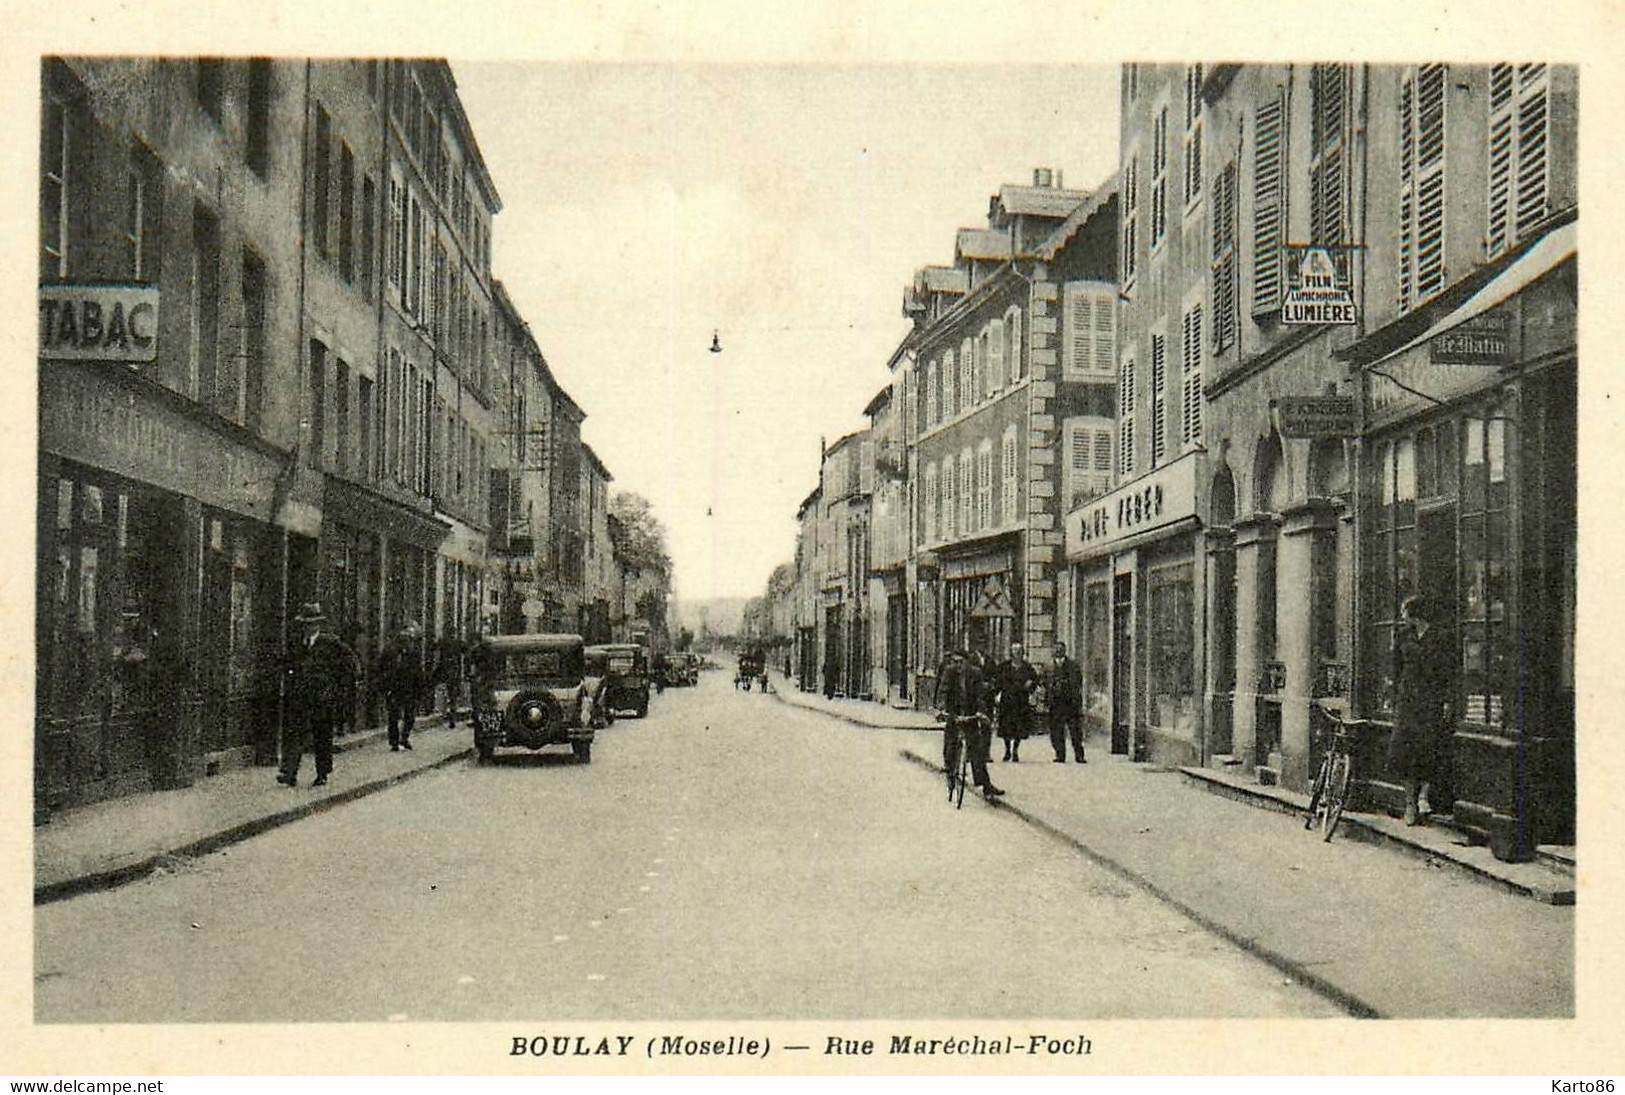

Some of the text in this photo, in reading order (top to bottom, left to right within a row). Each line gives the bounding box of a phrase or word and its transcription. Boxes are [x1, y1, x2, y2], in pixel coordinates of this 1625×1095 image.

[1284, 303, 1353, 321] LUMIÈRE
[40, 299, 153, 349] TABAC
[1457, 335, 1505, 354] Matin
